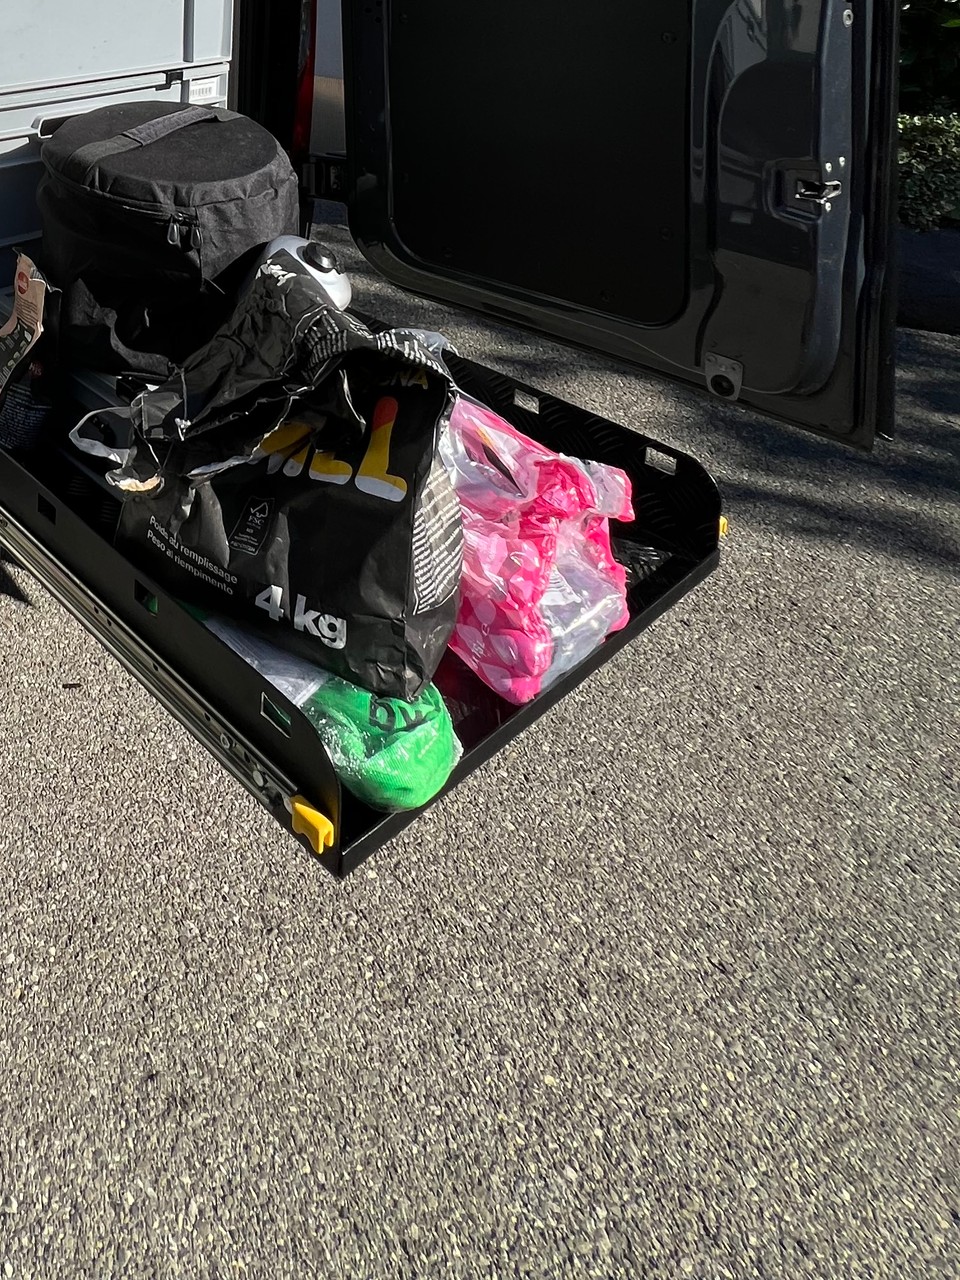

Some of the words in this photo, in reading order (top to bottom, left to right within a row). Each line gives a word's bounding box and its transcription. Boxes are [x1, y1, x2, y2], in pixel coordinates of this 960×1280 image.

[147, 529, 166, 552] Peso
[166, 548, 174, 559] al
[174, 554, 234, 596] riempimento
[149, 515, 169, 540] Poids
[168, 532, 179, 550] au
[180, 544, 238, 584] remplissage
[254, 584, 285, 622] 4
[293, 593, 347, 650] kg
